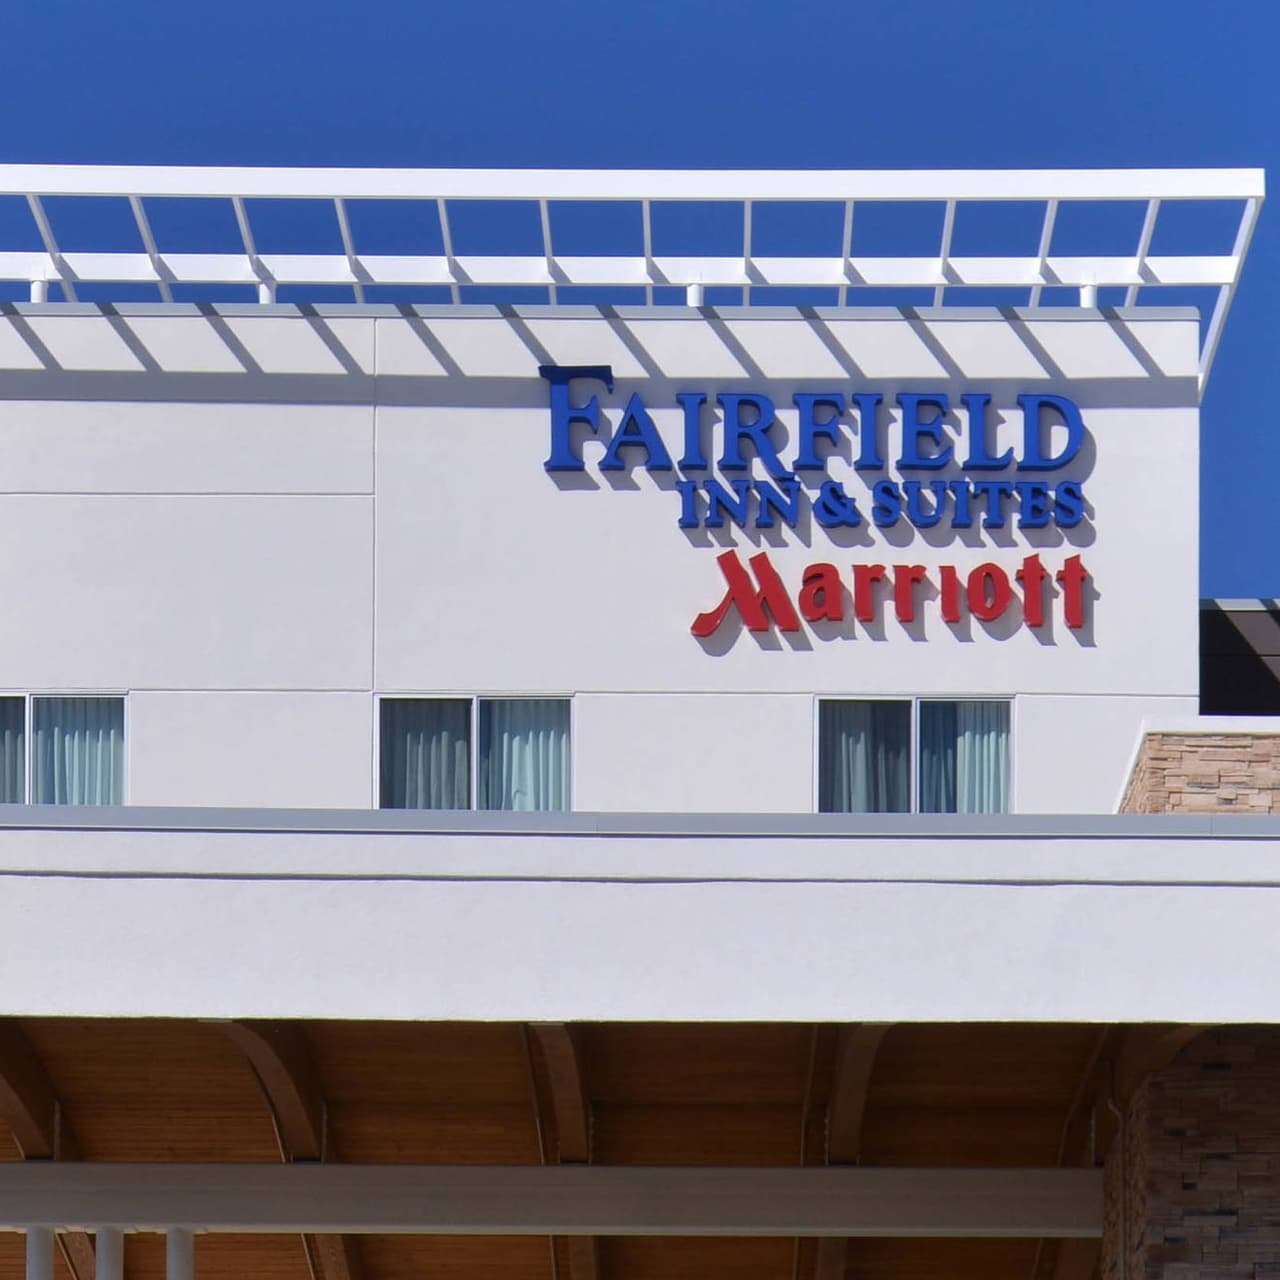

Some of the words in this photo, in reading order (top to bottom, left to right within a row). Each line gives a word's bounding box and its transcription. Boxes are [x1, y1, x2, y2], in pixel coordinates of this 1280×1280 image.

[538, 365, 1086, 480] FAIRFIELD
[676, 479, 801, 529] INN
[812, 480, 863, 529] &
[872, 480, 1084, 529] SUITES
[690, 548, 1089, 637] Marriott
